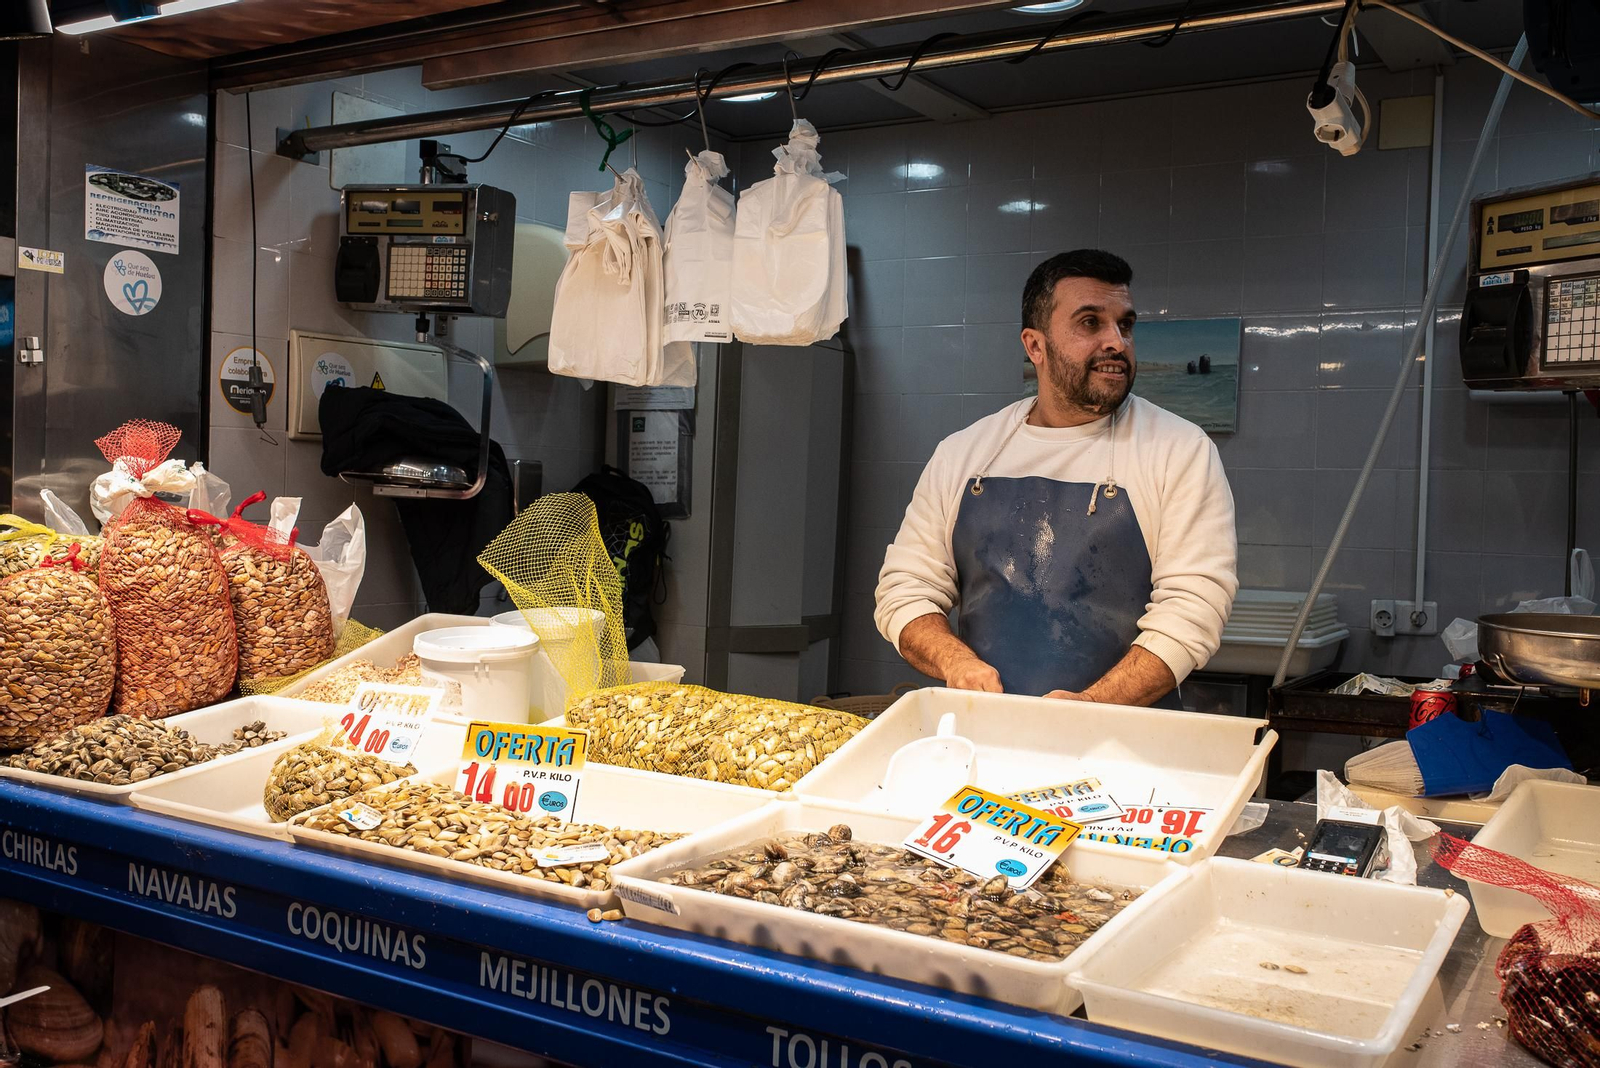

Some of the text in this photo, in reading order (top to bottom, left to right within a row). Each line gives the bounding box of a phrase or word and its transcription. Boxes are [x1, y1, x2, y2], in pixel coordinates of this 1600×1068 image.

[332, 712, 390, 754] 24 00
[475, 730, 576, 768] OFERTA
[462, 762, 535, 812] 14 00
[523, 770, 572, 782] P.V.P. KILO
[957, 794, 1066, 847] OFERTA
[2, 830, 78, 876] CHIRLAS
[1020, 845, 1044, 859] KILO
[128, 862, 236, 918] NAVAJAS
[287, 902, 426, 969] COQUINAS
[480, 952, 671, 1035] MEJILLONES
